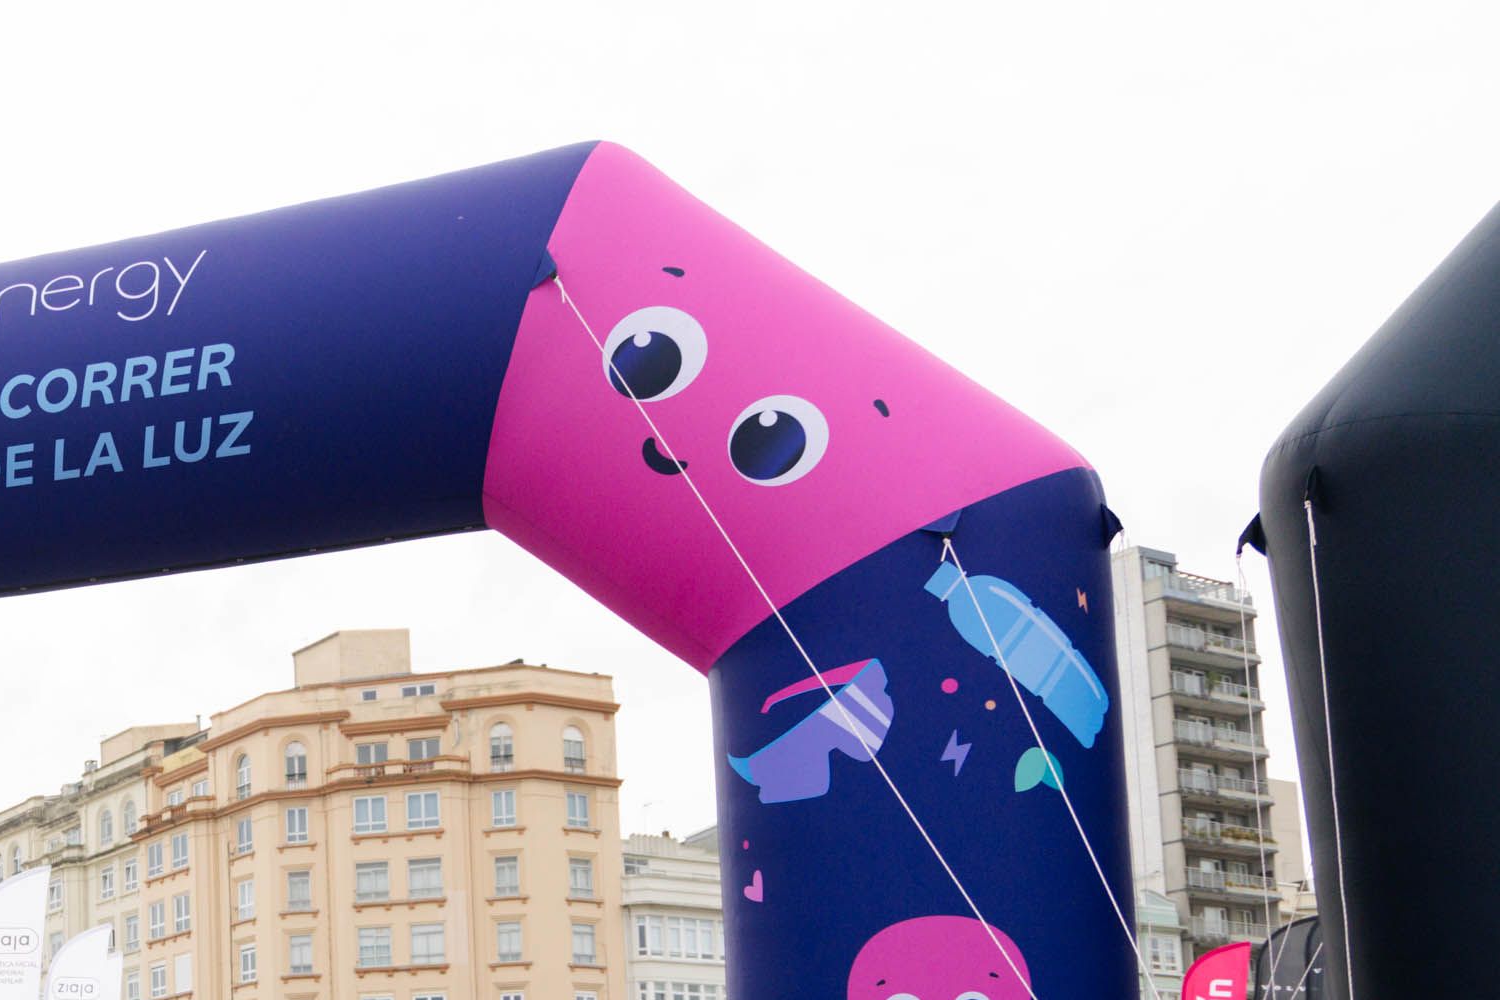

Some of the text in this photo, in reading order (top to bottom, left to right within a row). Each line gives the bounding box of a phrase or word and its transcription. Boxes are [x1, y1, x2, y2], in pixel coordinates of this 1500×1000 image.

[0, 343, 237, 419] CORRER
[53, 432, 124, 481] LA
[143, 411, 254, 470] LUZ
[58, 983, 94, 997] ziaja
